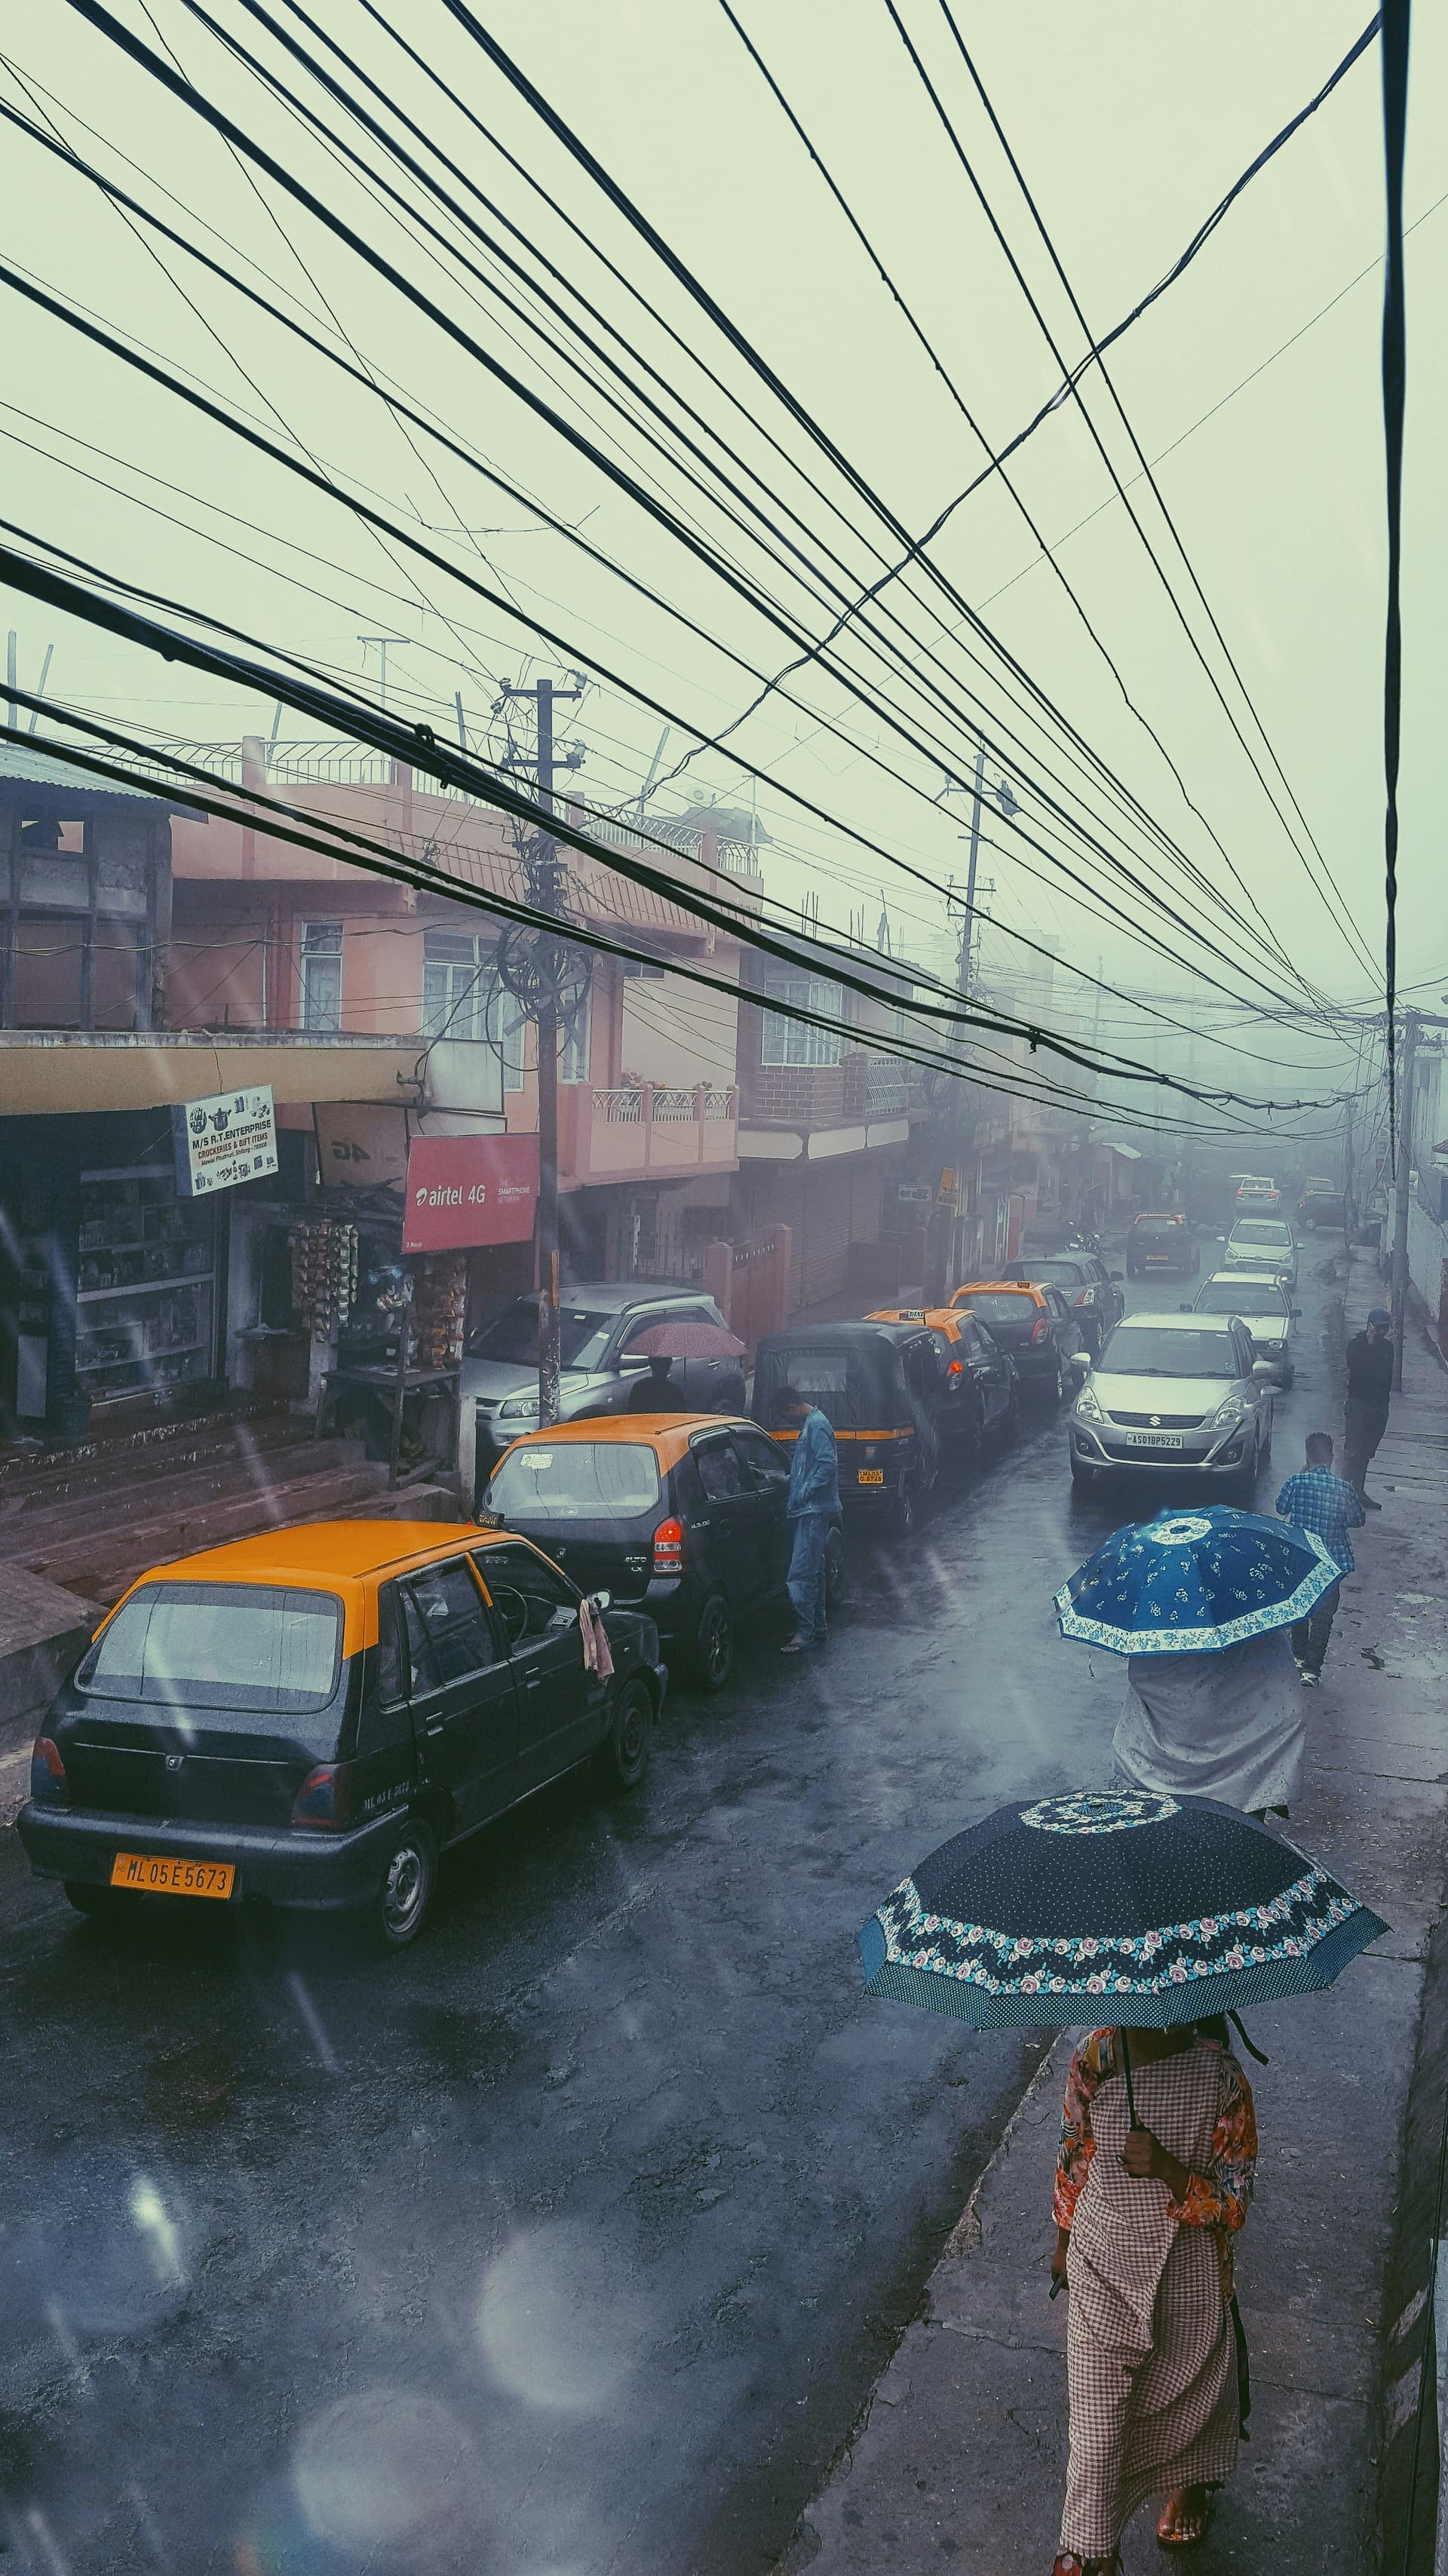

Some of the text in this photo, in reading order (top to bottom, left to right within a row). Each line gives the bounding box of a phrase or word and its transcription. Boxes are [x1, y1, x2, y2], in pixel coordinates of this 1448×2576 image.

[192, 1137, 209, 1150] M/S
[198, 1142, 232, 1159] CROCKERIES
[238, 1137, 250, 1147] GIFT
[252, 1132, 268, 1143] ITEMS
[428, 1185, 486, 1207] airtel 4G
[498, 1186, 531, 1195] SMARTPHONE
